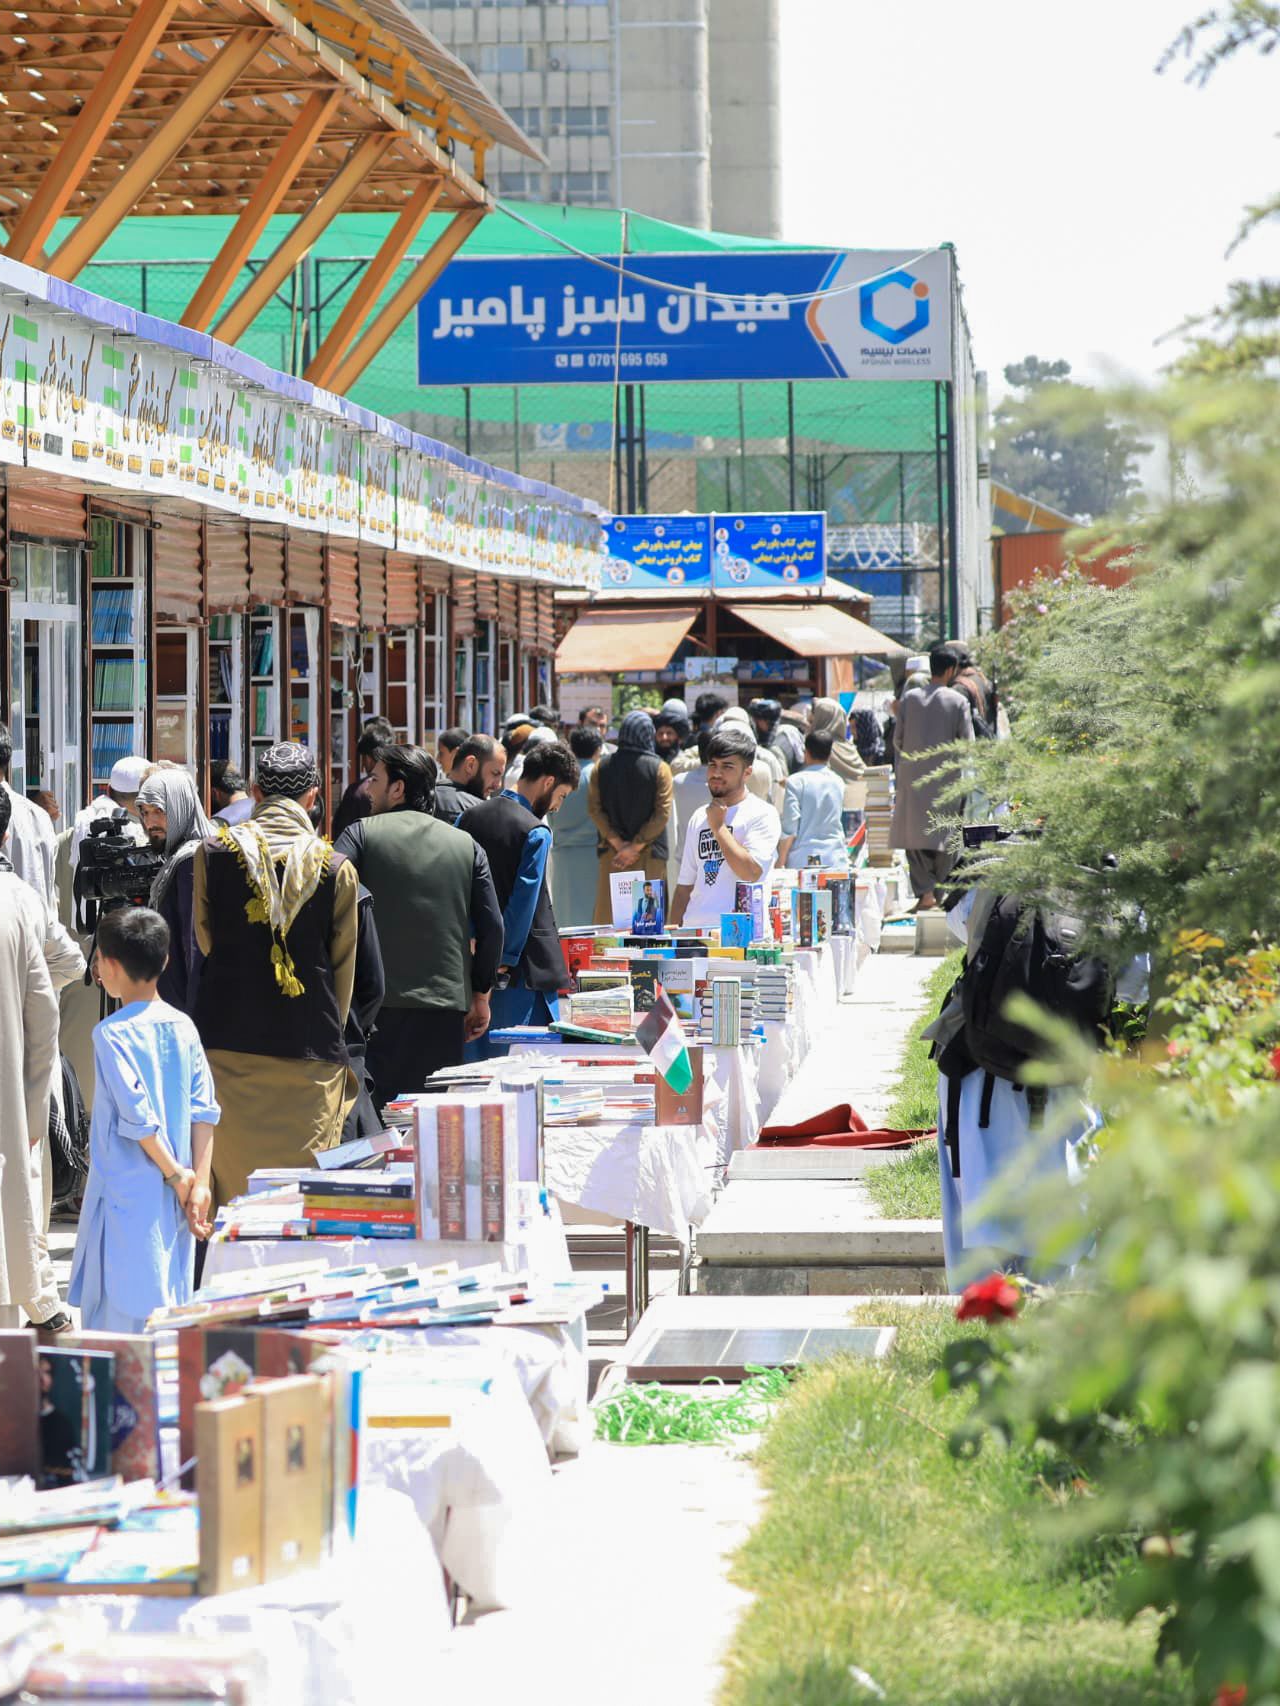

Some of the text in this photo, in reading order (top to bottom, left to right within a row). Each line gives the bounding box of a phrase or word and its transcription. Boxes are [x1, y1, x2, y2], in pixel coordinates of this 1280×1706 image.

[432, 281, 790, 341] میدان سبز پامیر
[620, 353, 642, 367] 695
[645, 353, 668, 367] 058
